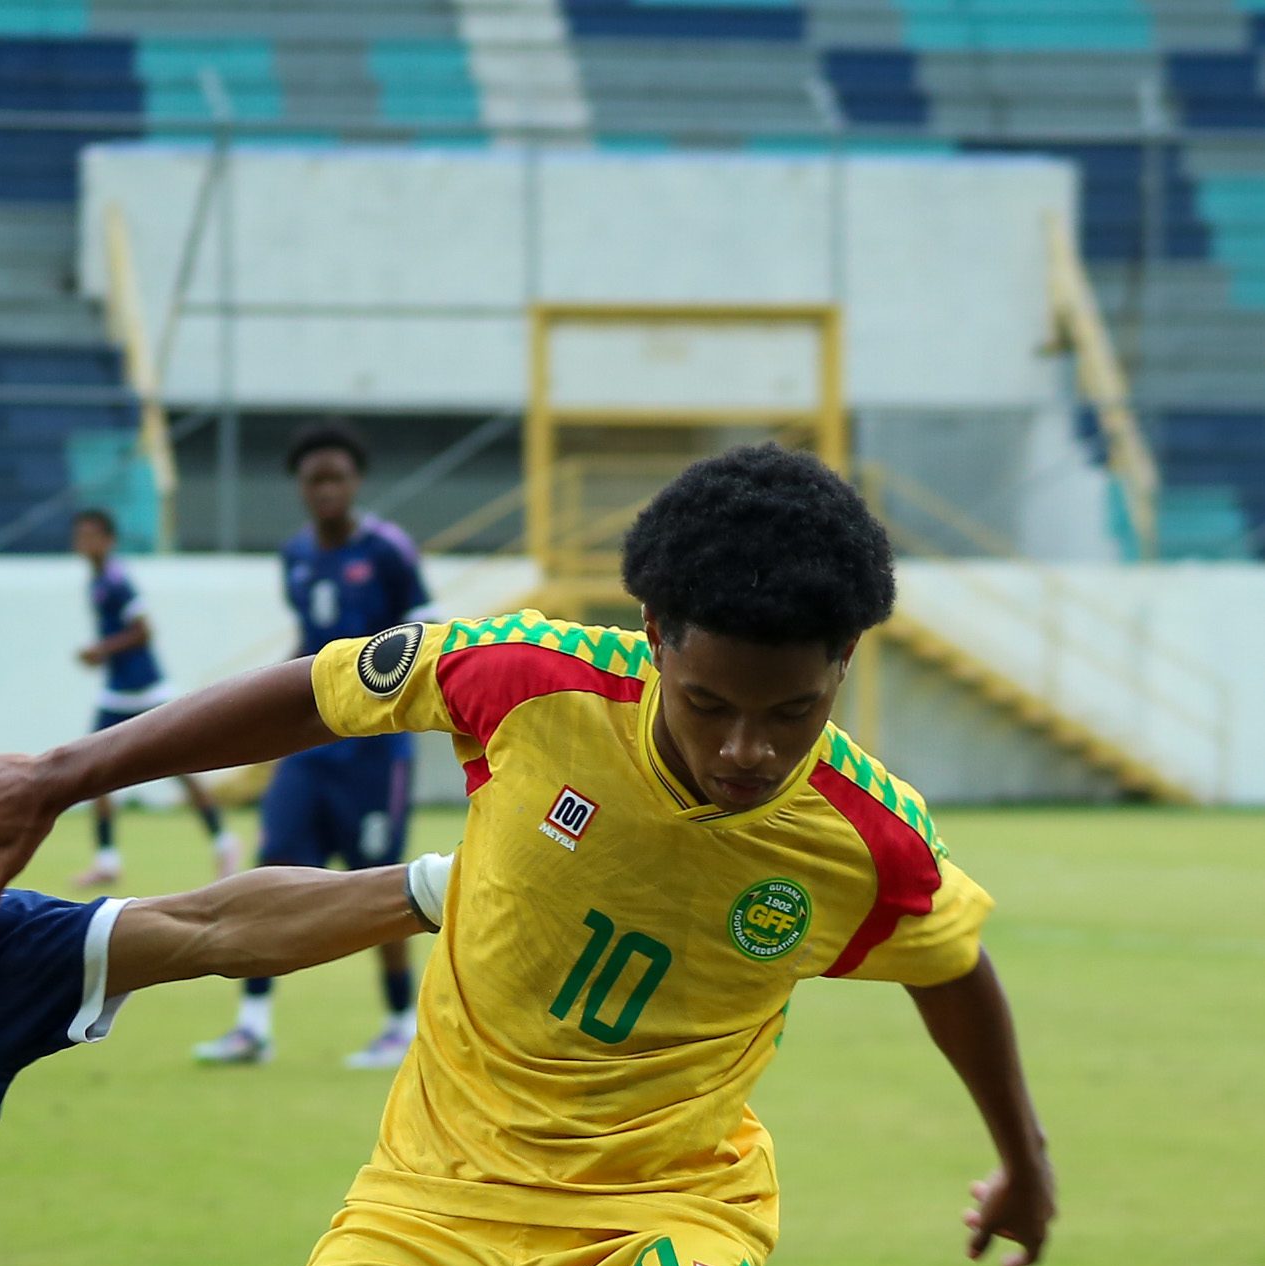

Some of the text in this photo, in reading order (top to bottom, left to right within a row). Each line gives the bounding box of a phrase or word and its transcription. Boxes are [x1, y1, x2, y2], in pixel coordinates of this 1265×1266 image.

[764, 895, 793, 913] 1902
[769, 884, 802, 902] GUYANA
[733, 909, 800, 955] FOOTBALL FEDERATION
[747, 904, 797, 934] GFF
[548, 908, 672, 1044] 10
